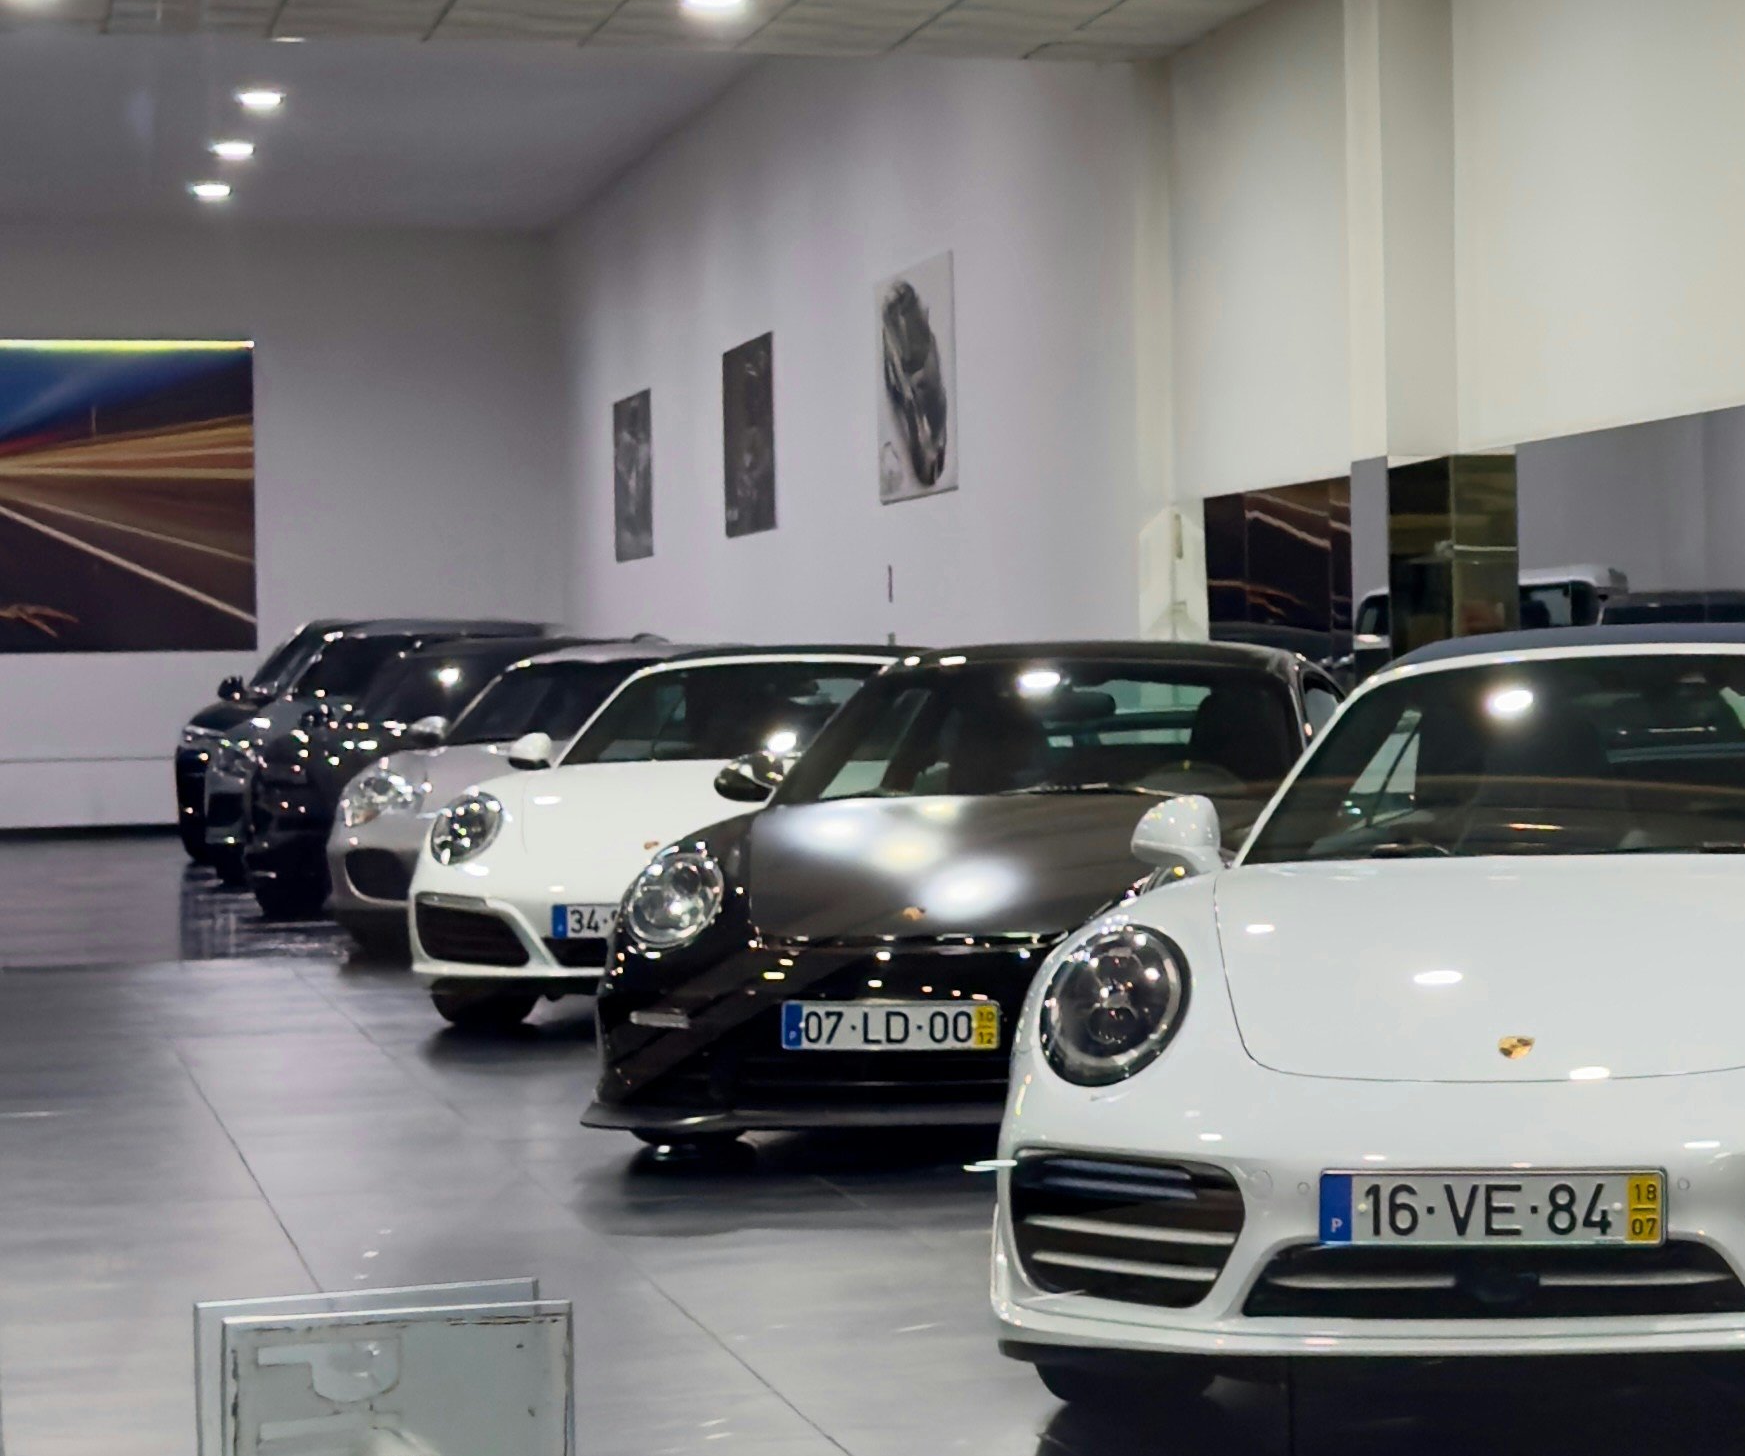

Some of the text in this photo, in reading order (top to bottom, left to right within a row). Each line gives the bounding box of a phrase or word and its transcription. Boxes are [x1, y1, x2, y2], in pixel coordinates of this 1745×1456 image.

[1635, 1183, 1657, 1202] 18
[1331, 1218, 1343, 1233] P
[1632, 1217, 1657, 1236] 07
